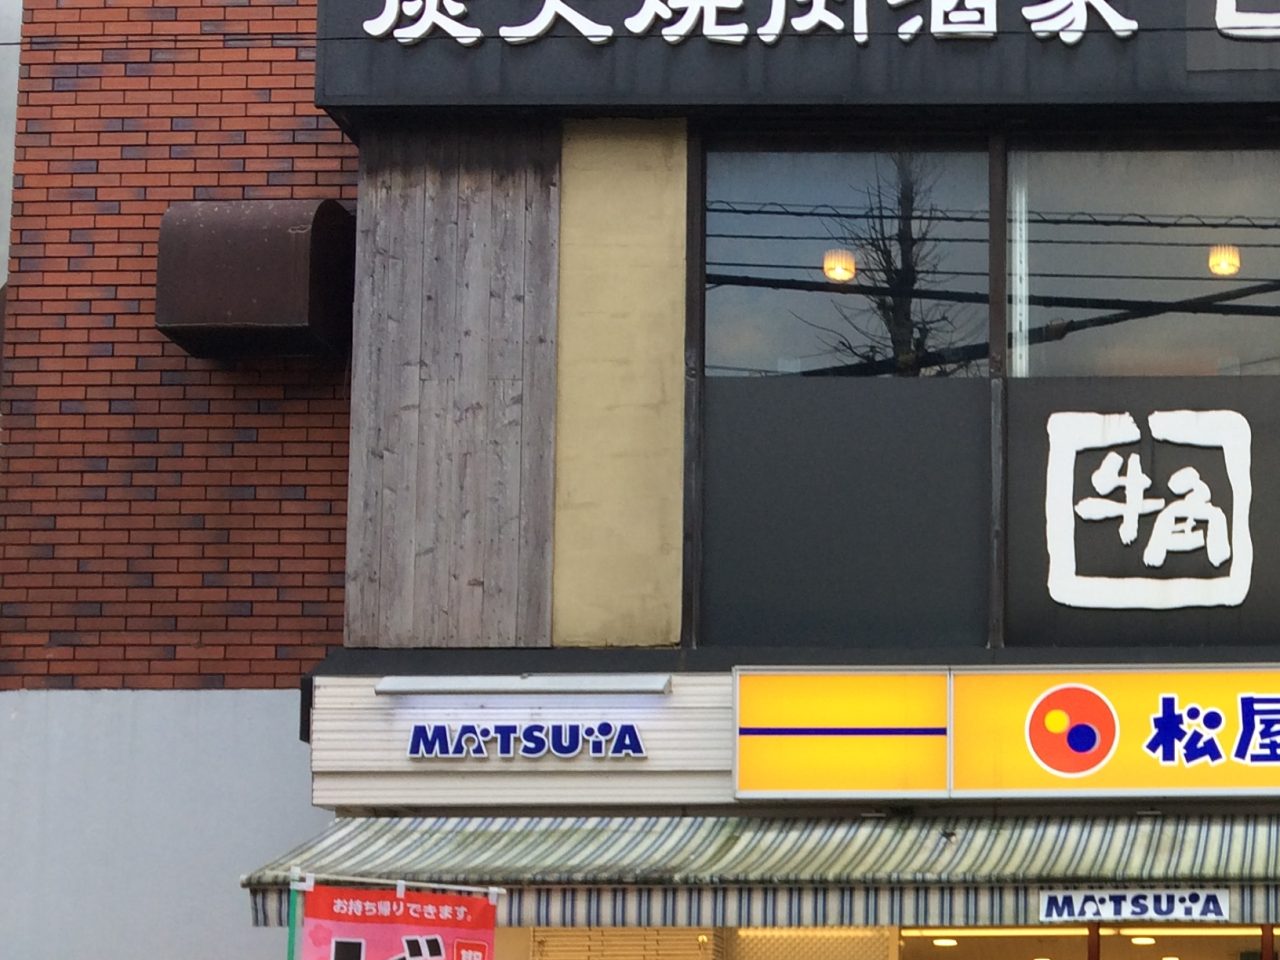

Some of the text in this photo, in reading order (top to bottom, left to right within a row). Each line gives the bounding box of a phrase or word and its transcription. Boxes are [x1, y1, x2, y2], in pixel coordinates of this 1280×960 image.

[409, 721, 645, 756] MATSUYA
[333, 898, 473, 922] お持ち帰りできます。
[1045, 892, 1224, 917] MATSUYA
